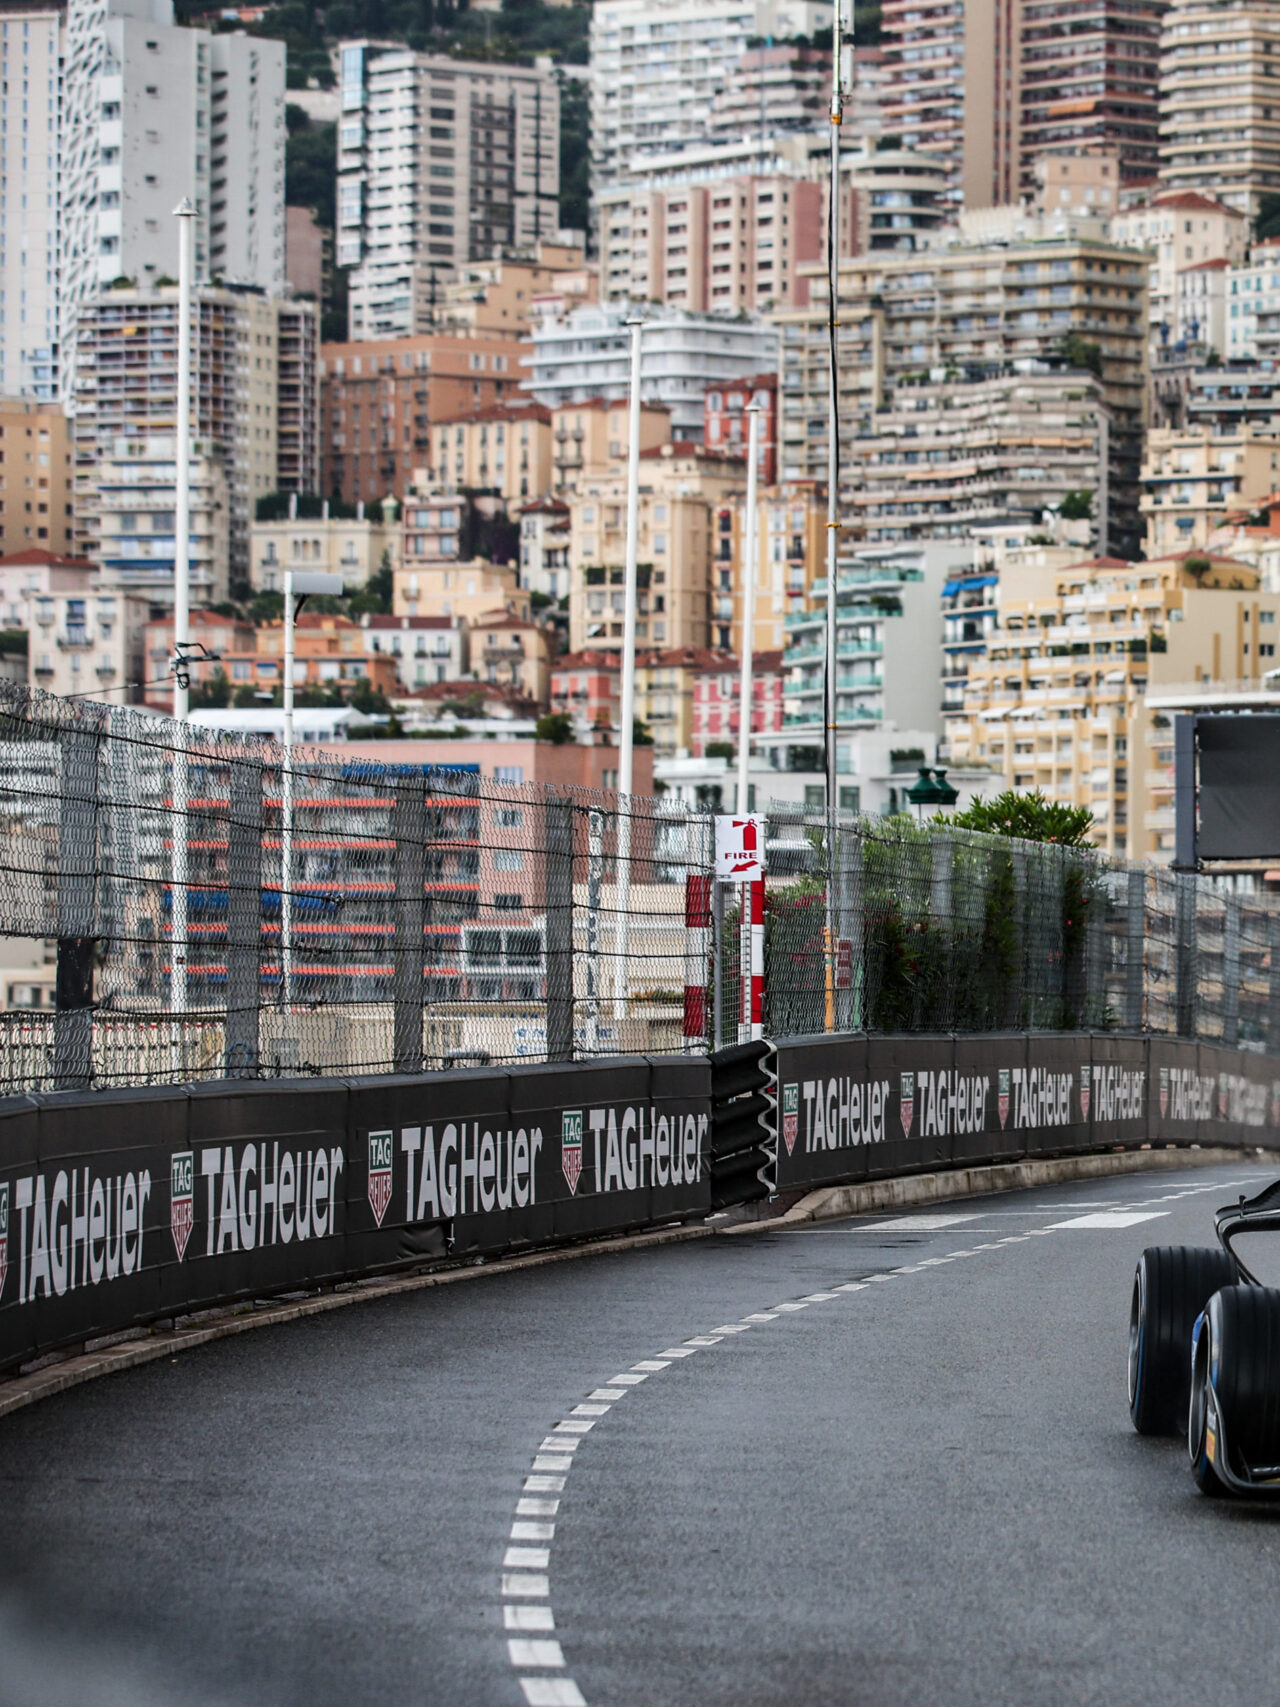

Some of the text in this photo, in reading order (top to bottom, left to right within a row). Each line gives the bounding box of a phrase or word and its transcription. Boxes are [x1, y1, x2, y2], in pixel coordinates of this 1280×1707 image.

[724, 851, 758, 860] FIRE
[370, 1137, 391, 1167] TAG
[563, 1117, 581, 1142] TAG
[589, 1106, 708, 1193] TAGHeuer
[803, 1076, 890, 1153] TAGHeuer
[172, 1159, 192, 1193] TAG
[202, 1141, 344, 1256] TAGHeuer
[401, 1121, 543, 1222] TAGHeuer
[15, 1166, 152, 1305] TAGHeuer
